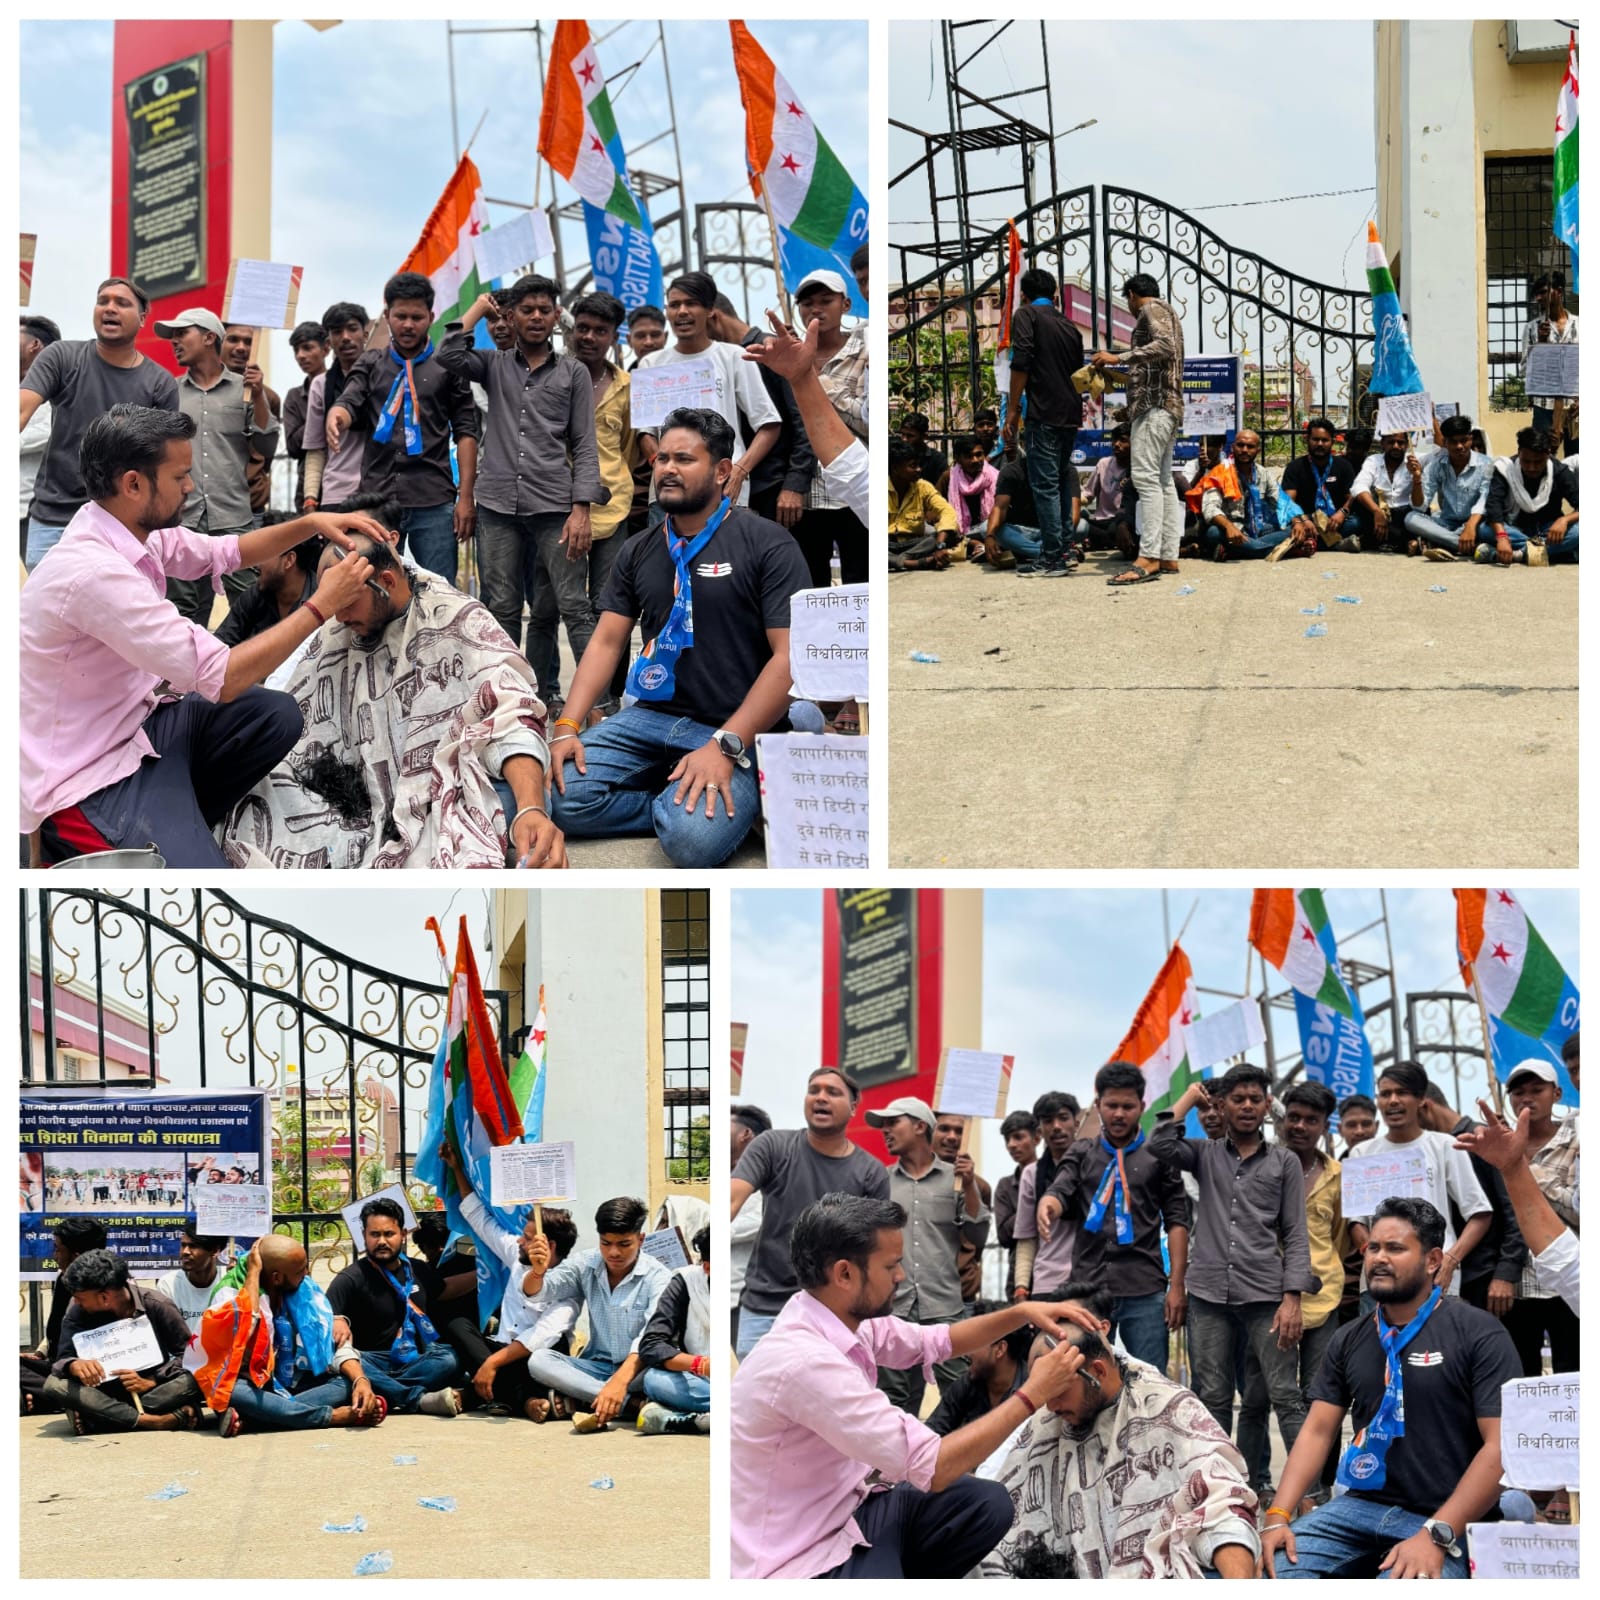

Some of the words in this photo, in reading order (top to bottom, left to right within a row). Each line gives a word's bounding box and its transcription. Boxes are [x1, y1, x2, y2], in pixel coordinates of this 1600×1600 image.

[806, 593, 849, 608] नियमित
[838, 617, 867, 633] लाओ
[806, 644, 869, 660] विश्वविद्याल
[792, 769, 816, 784] वाले
[794, 795, 818, 811] वाले
[38, 1129, 78, 1144] शिक्षा
[82, 1129, 134, 1144] विभाग
[138, 1130, 158, 1144] की
[162, 1132, 221, 1145] शवयात्रा
[1517, 1382, 1560, 1398] नियमित
[1548, 1406, 1577, 1422] लाओ
[1517, 1433, 1580, 1449] विश्वविद्याल
